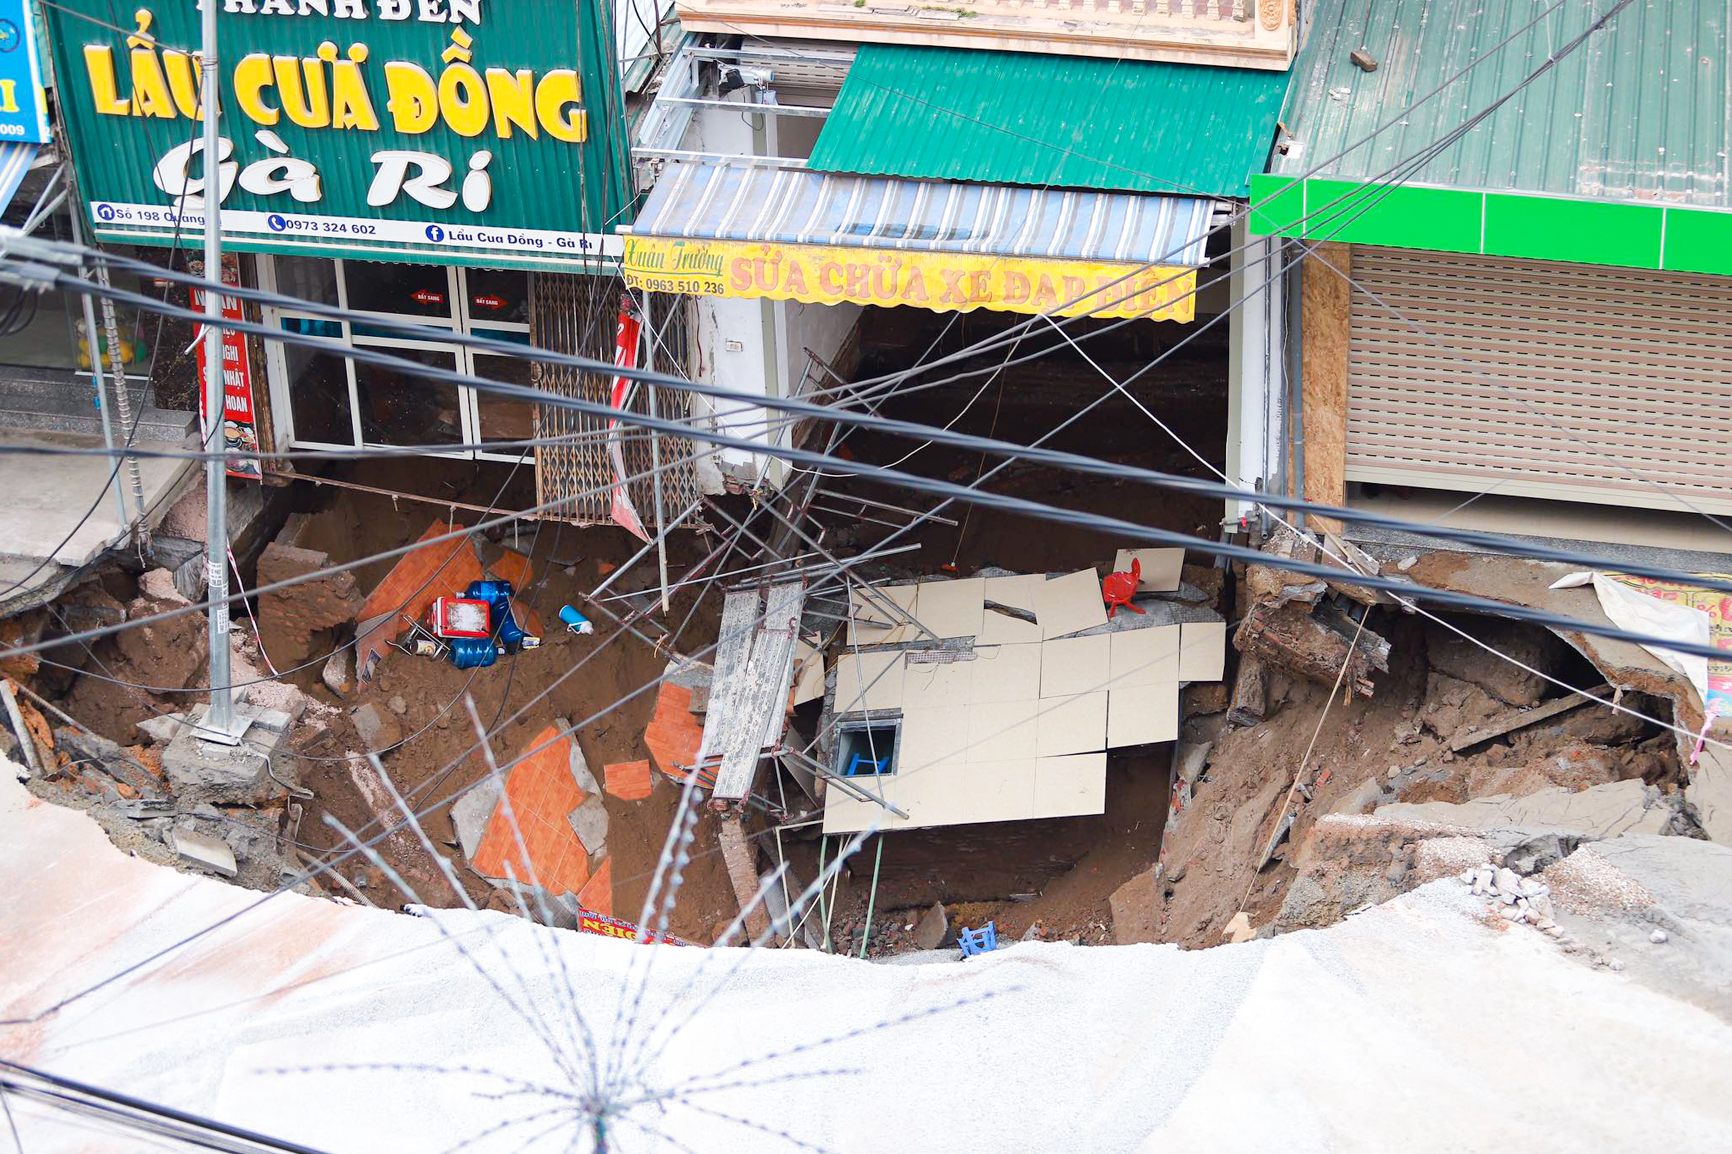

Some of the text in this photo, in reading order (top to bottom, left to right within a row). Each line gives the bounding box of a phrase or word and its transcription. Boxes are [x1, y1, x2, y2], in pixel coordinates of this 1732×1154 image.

[84, 8, 220, 121] LẨU
[384, 25, 587, 142] ĐỒNG
[153, 130, 492, 213] Gà Ri
[137, 211, 160, 221] 198
[286, 219, 377, 235] 0973 324 602
[477, 232, 503, 243] Cua
[507, 233, 543, 248] Đồng
[556, 237, 575, 248] Gà
[625, 238, 665, 269] Xuân
[646, 278, 674, 291] 0963
[678, 281, 700, 292] 510
[704, 282, 725, 294] 236
[730, 243, 808, 295] SỬA
[820, 255, 929, 301] CHỮA
[939, 269, 992, 303] XE
[1002, 270, 1086, 313] ĐẠP
[225, 394, 248, 413] HOAN
